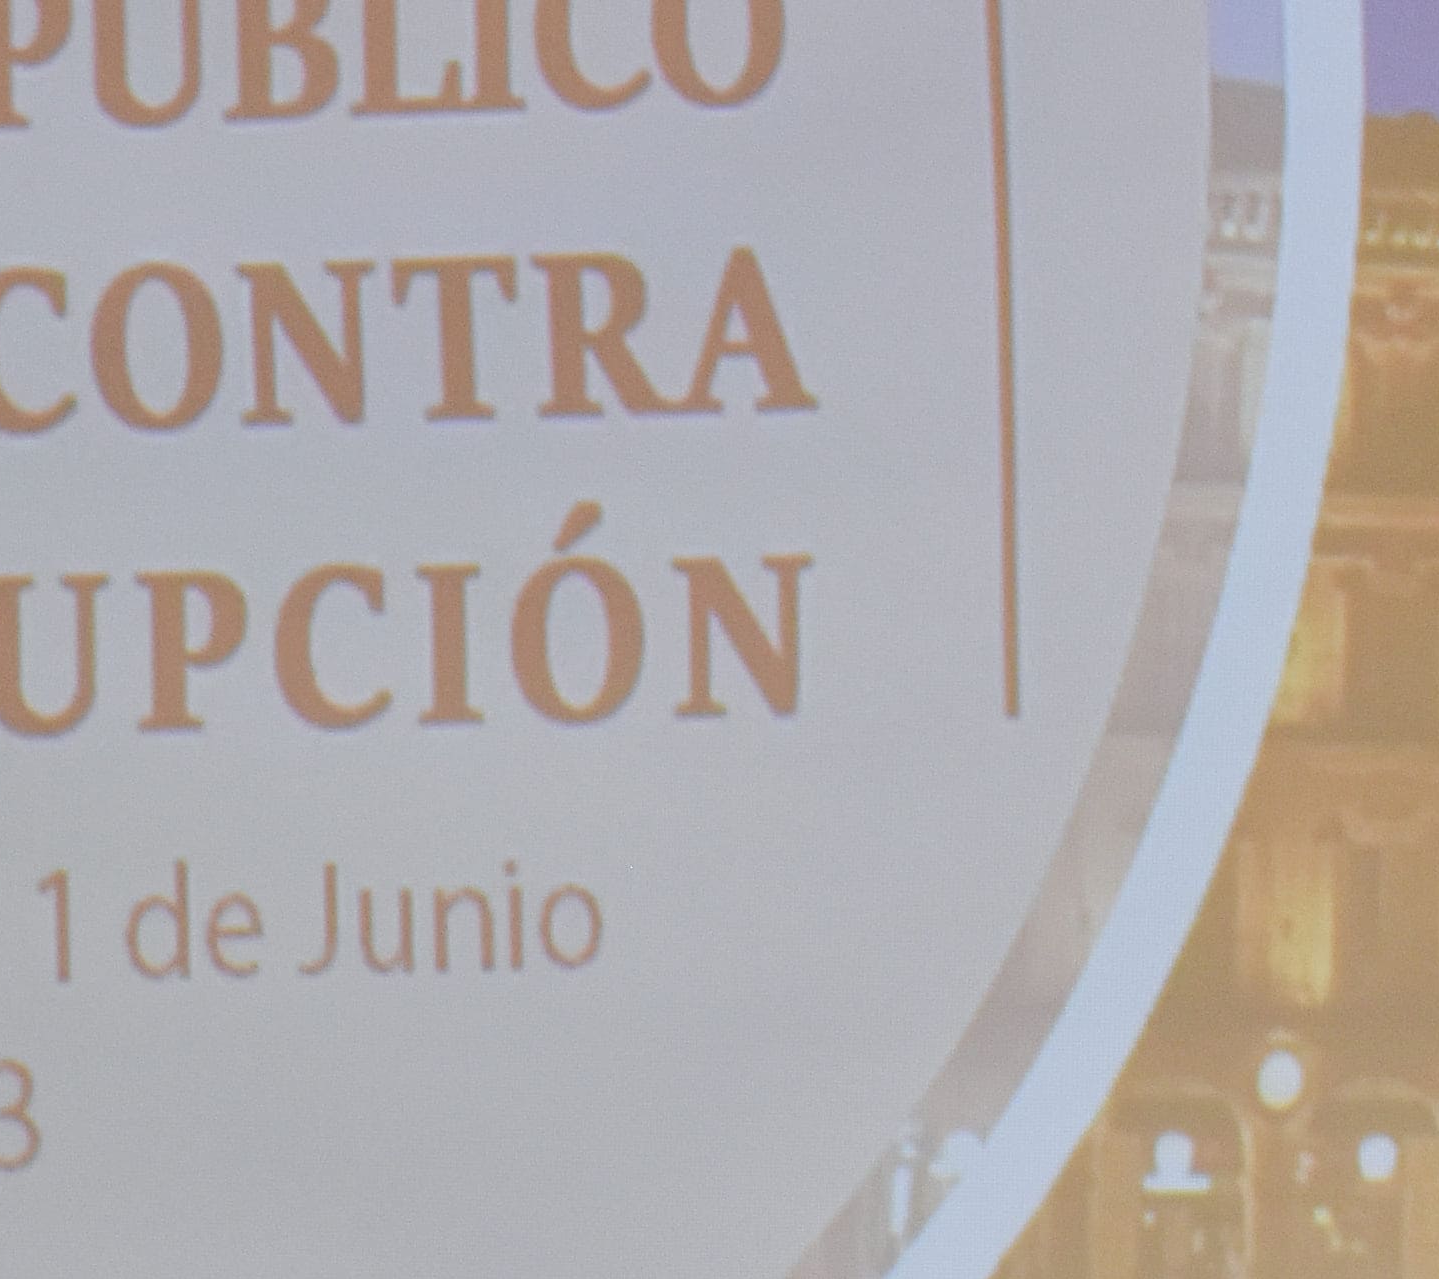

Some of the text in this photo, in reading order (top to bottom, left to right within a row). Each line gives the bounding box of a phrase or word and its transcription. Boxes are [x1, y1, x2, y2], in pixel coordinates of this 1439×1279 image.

[40, 868, 71, 980] 1
[126, 859, 262, 977] de
[302, 861, 604, 974] Junio
